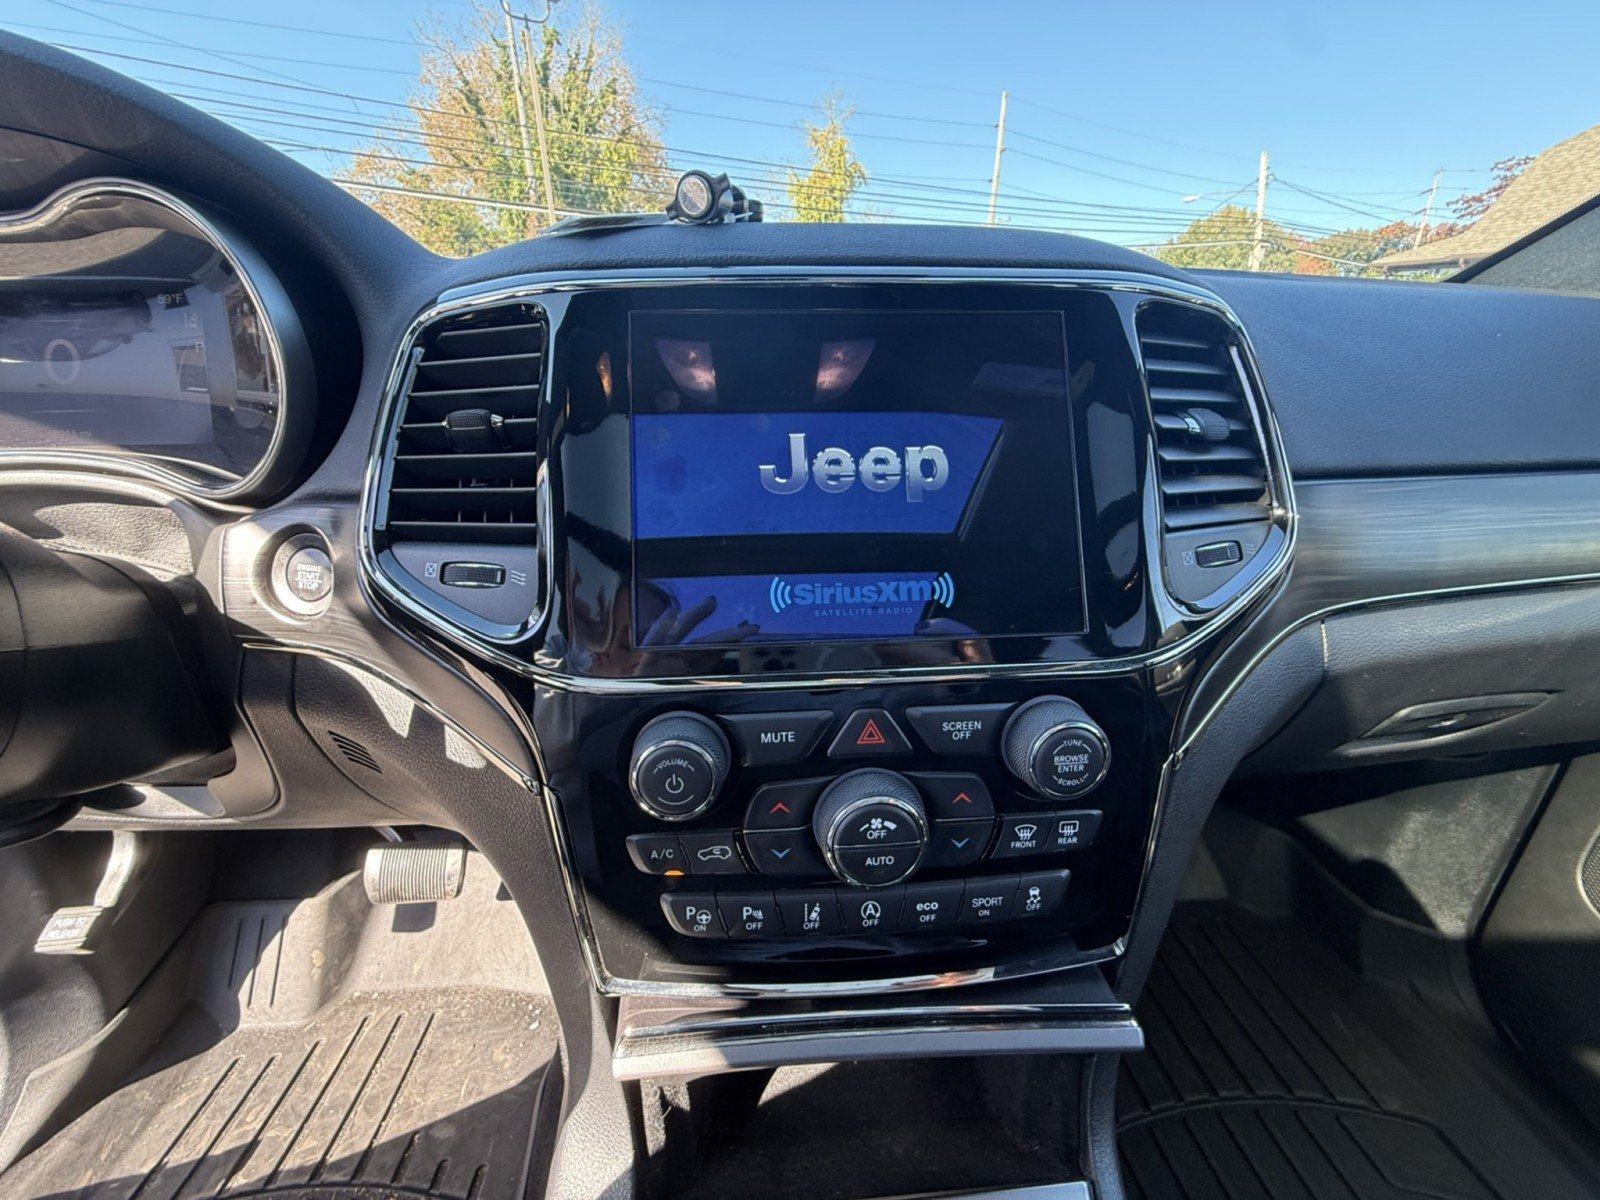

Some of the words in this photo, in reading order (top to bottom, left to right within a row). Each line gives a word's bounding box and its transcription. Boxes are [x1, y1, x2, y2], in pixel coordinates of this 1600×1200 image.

[758, 433, 949, 503] Jeep
[297, 571, 320, 581] START
[298, 582, 318, 590] STOP
[814, 608, 873, 617] SATELLITE
[878, 607, 913, 615] RADIO
[942, 720, 982, 731] SCREEN
[760, 731, 796, 744] MUTE
[952, 730, 972, 740] OFF
[1063, 738, 1083, 747] TUNE
[656, 758, 689, 770] VOLUME
[1053, 754, 1089, 764] BROWSE
[1058, 764, 1084, 773] ENTER
[1057, 777, 1084, 786] SCROLL
[866, 829, 888, 840] OFF
[1010, 839, 1036, 849] FRONT
[1057, 836, 1078, 845] REAR
[650, 849, 674, 860] A/C
[865, 855, 895, 867] AUTO
[916, 901, 939, 912] eco
[971, 896, 1004, 908] SPORT
[1025, 902, 1042, 912] OFF
[978, 908, 990, 917] ON
[862, 919, 880, 928] OFF
[919, 914, 937, 923] OFF
[693, 924, 707, 932] ON
[745, 921, 764, 931] OFF
[803, 921, 820, 931] OFF
